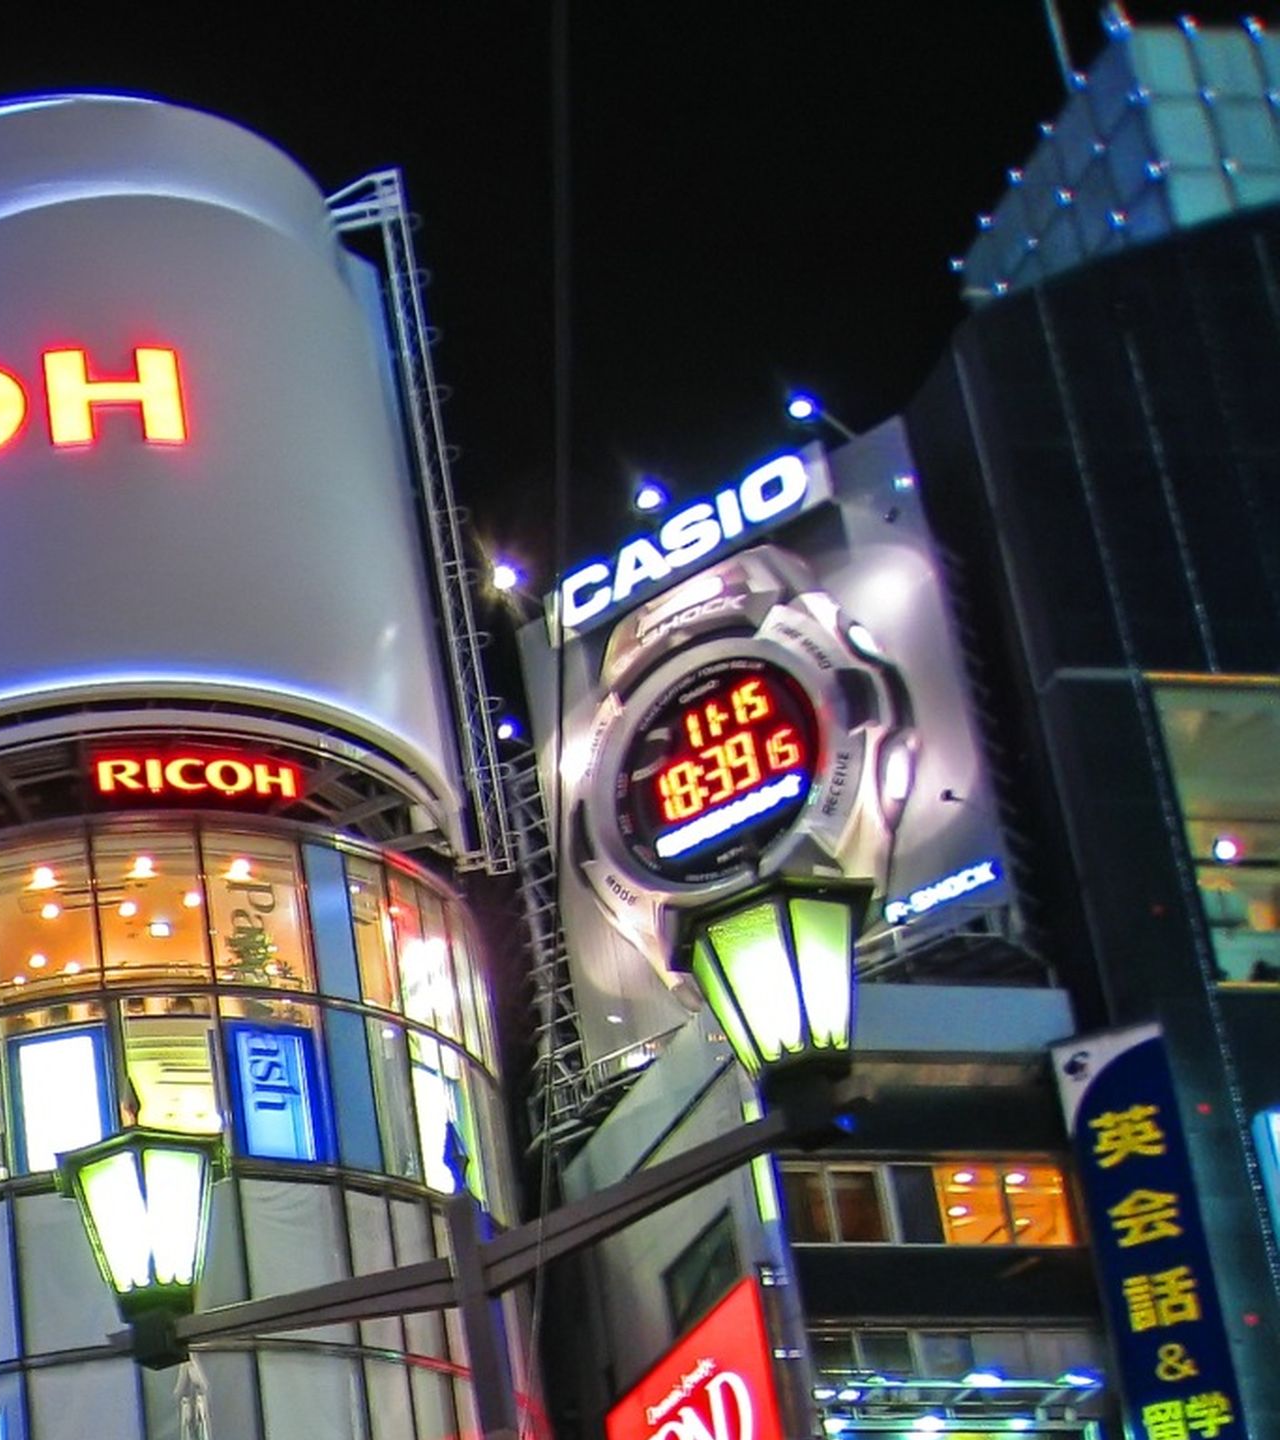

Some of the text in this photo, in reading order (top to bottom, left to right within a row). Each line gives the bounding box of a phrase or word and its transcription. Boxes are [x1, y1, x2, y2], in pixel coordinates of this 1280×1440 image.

[562, 454, 809, 630] CASIO
[97, 757, 298, 798] RICOH
[657, 730, 763, 822] 18:39
[821, 750, 852, 817] RECEIVE
[604, 873, 639, 906] MODE
